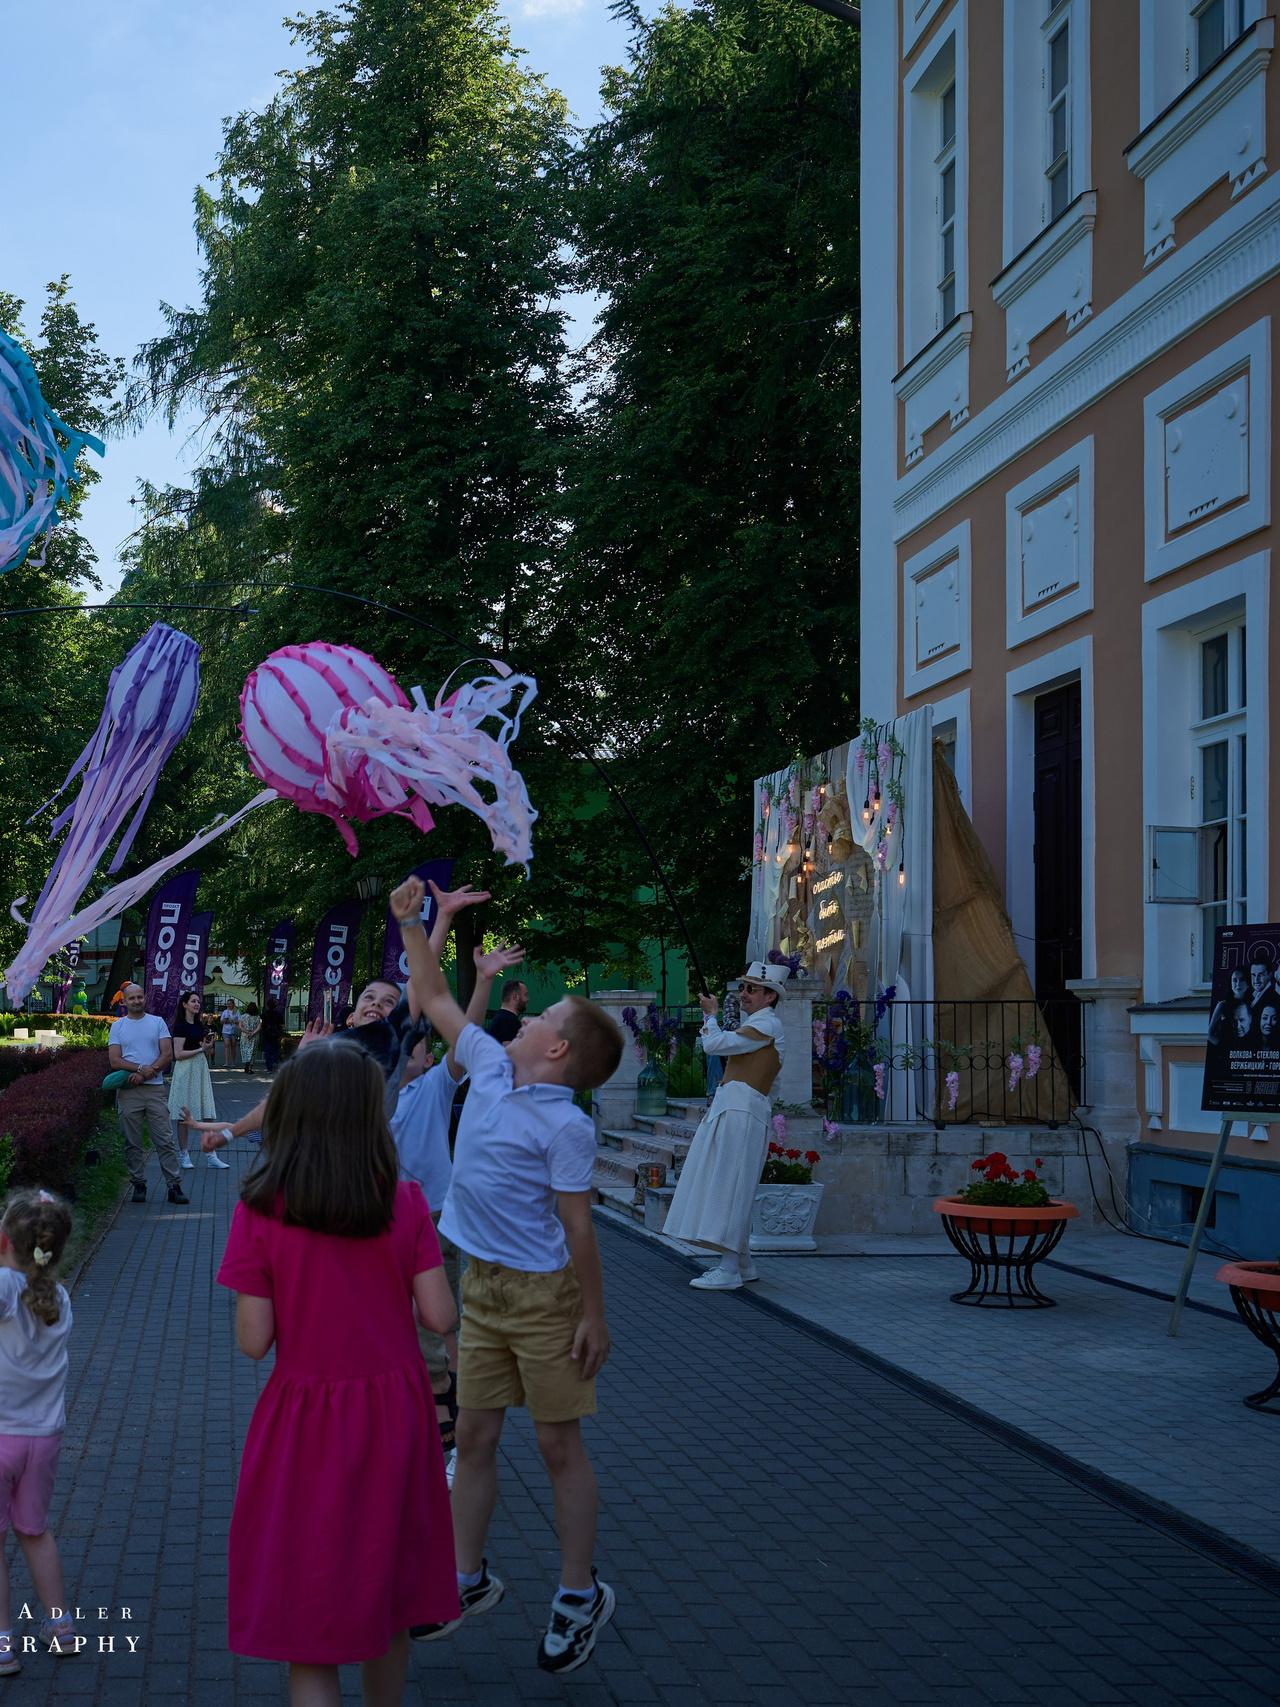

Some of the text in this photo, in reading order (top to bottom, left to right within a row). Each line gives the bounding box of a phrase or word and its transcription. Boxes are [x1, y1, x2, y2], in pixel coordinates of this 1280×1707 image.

[152, 902, 182, 992] ПОЭТ
[1229, 1050, 1280, 1059] ВОЛКОВА СТЕКЛОВ
[1230, 1060, 1280, 1071] ВЕРЖБИЦКИЙ ГОР
